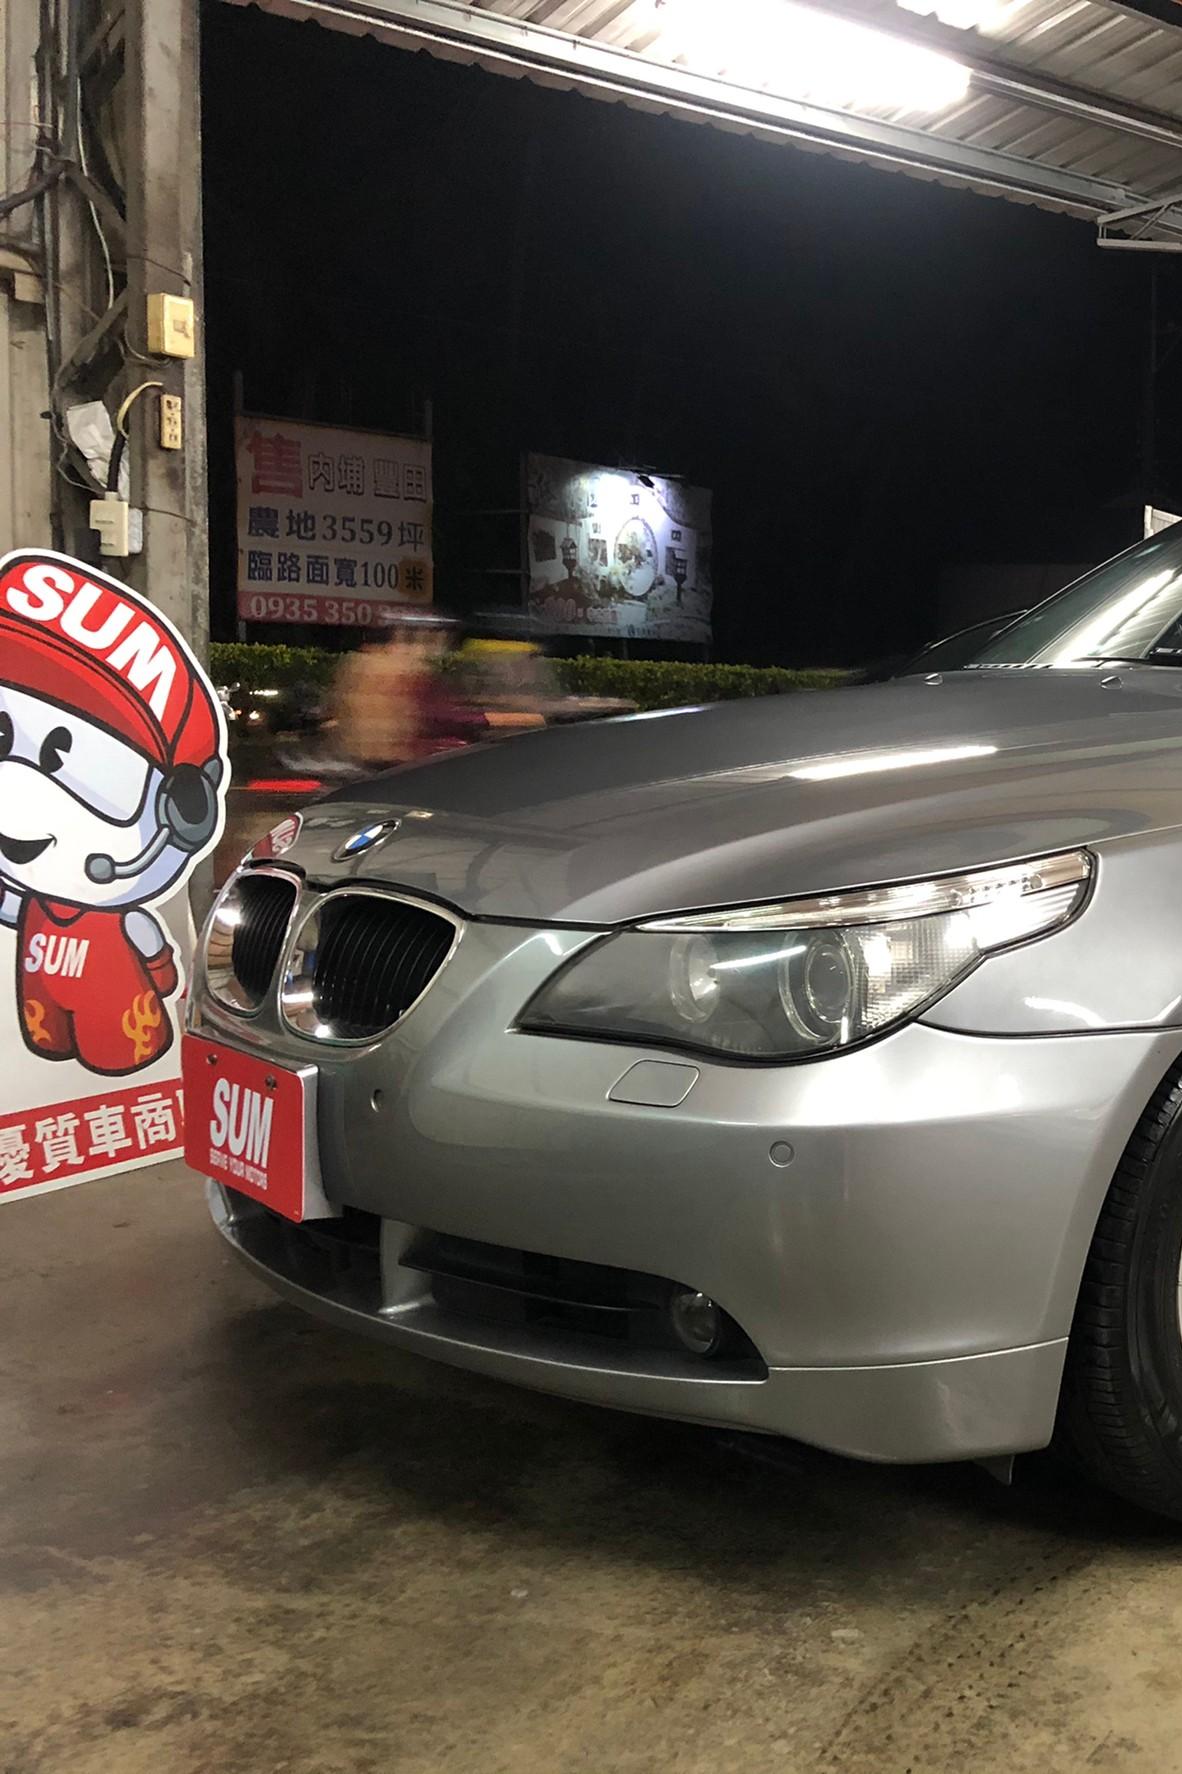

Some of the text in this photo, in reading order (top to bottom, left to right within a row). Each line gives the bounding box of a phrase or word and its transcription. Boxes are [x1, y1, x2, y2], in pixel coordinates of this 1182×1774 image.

[247, 431, 303, 498] 售
[248, 506, 425, 552] 農地3559坪
[248, 550, 425, 592] 臨路面寬100米
[250, 595, 318, 622] 0935
[6, 564, 179, 722] SUM
[24, 932, 89, 979] SUM
[209, 1077, 274, 1169] SUM
